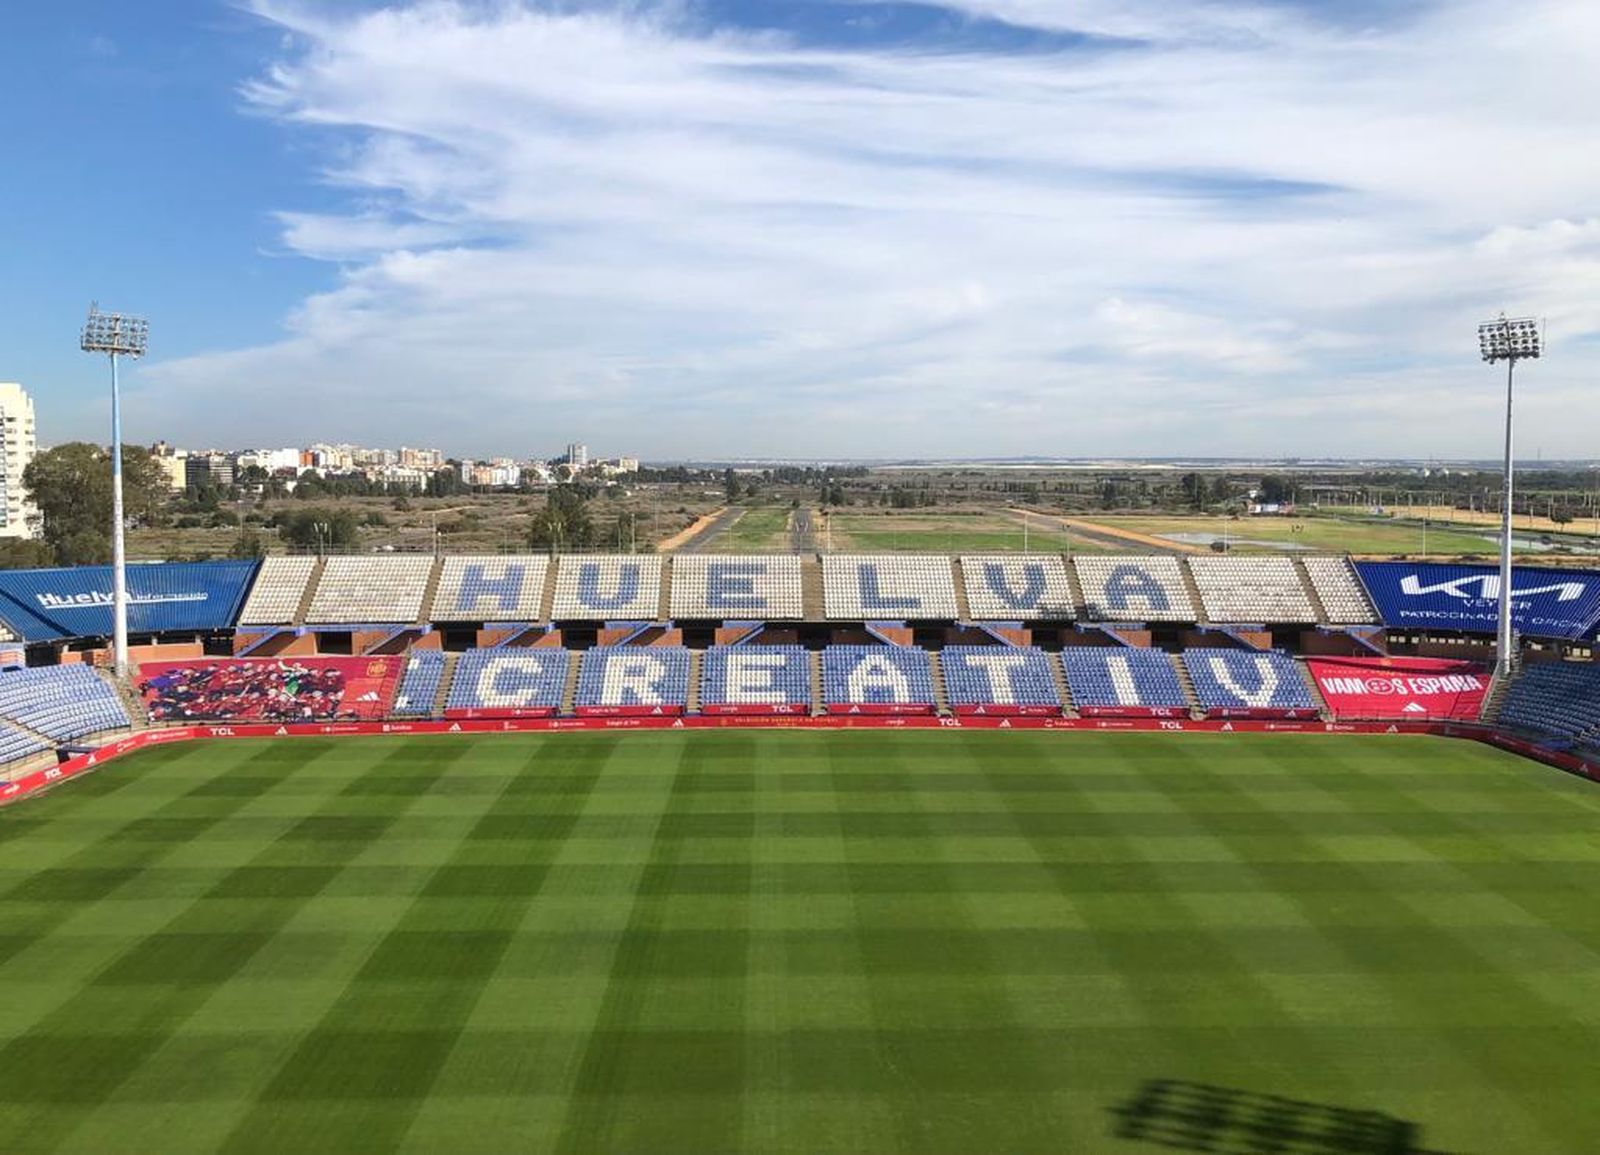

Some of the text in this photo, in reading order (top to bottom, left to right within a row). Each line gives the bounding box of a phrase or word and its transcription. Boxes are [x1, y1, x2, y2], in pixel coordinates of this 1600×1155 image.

[455, 563, 1171, 611] HUELVA
[1463, 599, 1532, 610] VEYER
[1400, 610, 1525, 624] PATROCINADR
[475, 653, 1280, 708] CREATIV
[772, 705, 794, 713] TCL
[1150, 707, 1173, 716] TCL
[938, 718, 962, 727] TCL
[1159, 721, 1184, 730] TCL
[210, 727, 235, 736] TCL
